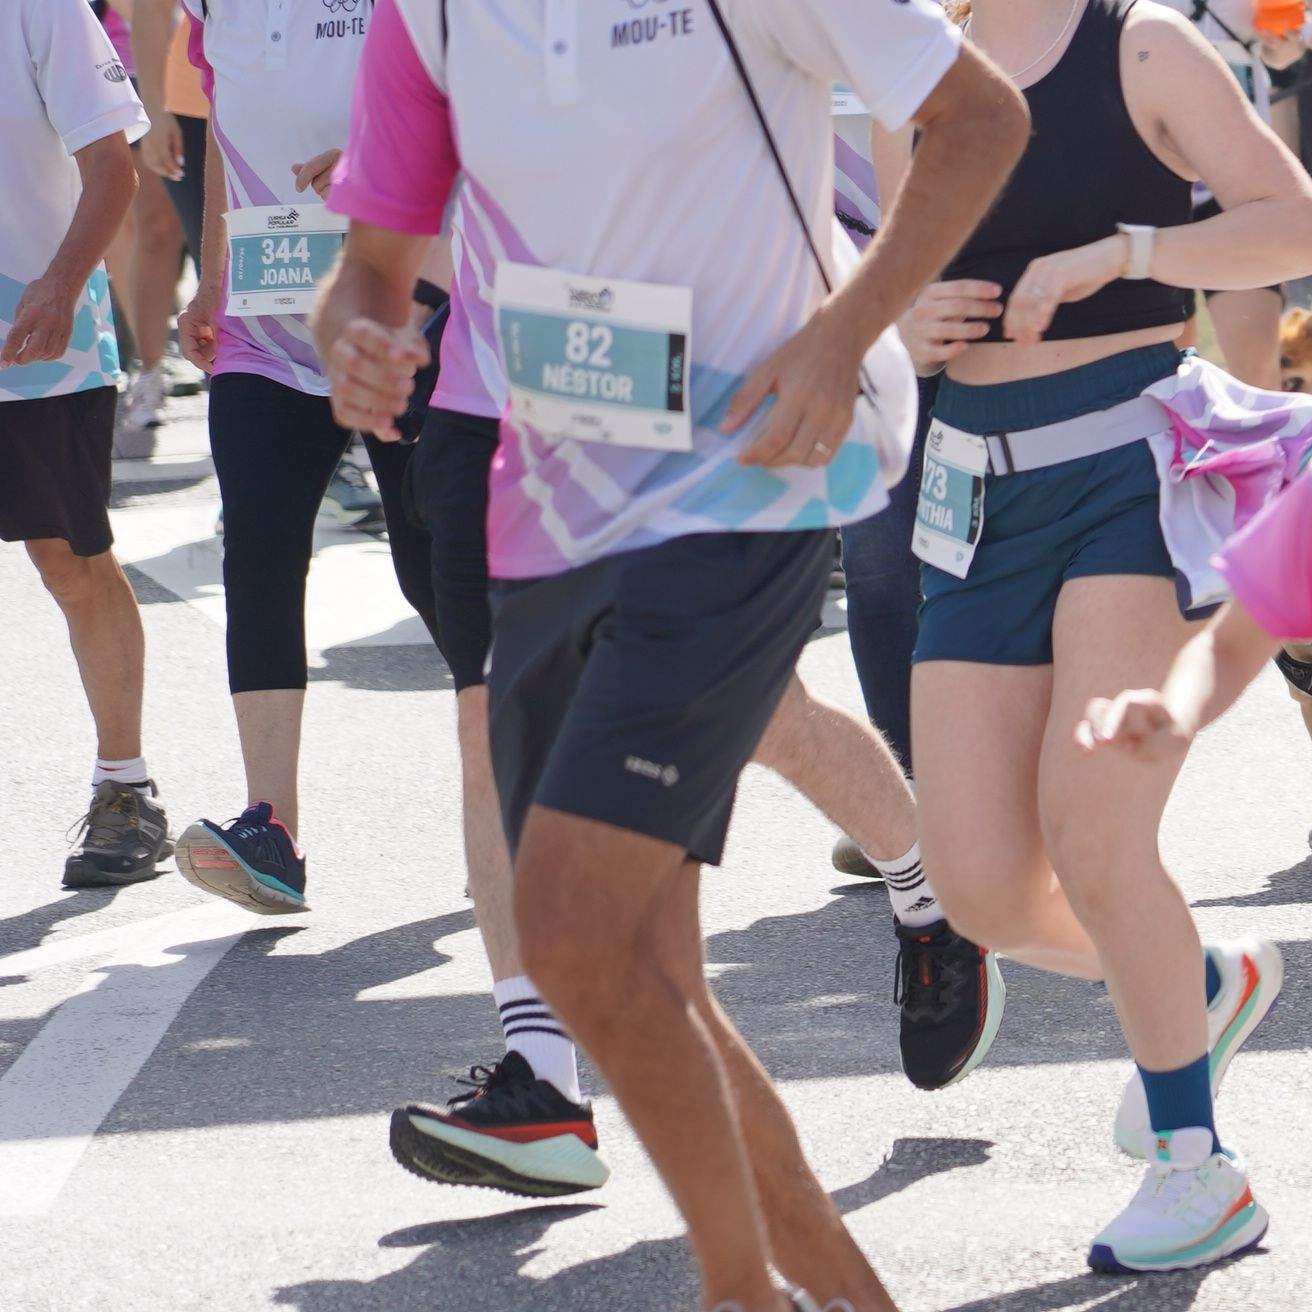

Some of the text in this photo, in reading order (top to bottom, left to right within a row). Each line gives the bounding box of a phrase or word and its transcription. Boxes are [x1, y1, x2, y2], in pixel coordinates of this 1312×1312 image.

[315, 17, 365, 39] MOU-TE
[611, 8, 694, 49] MOU-TE
[261, 236, 311, 265] 344
[260, 267, 314, 285] JOANA
[565, 322, 614, 368] 82
[922, 461, 948, 501] 73
